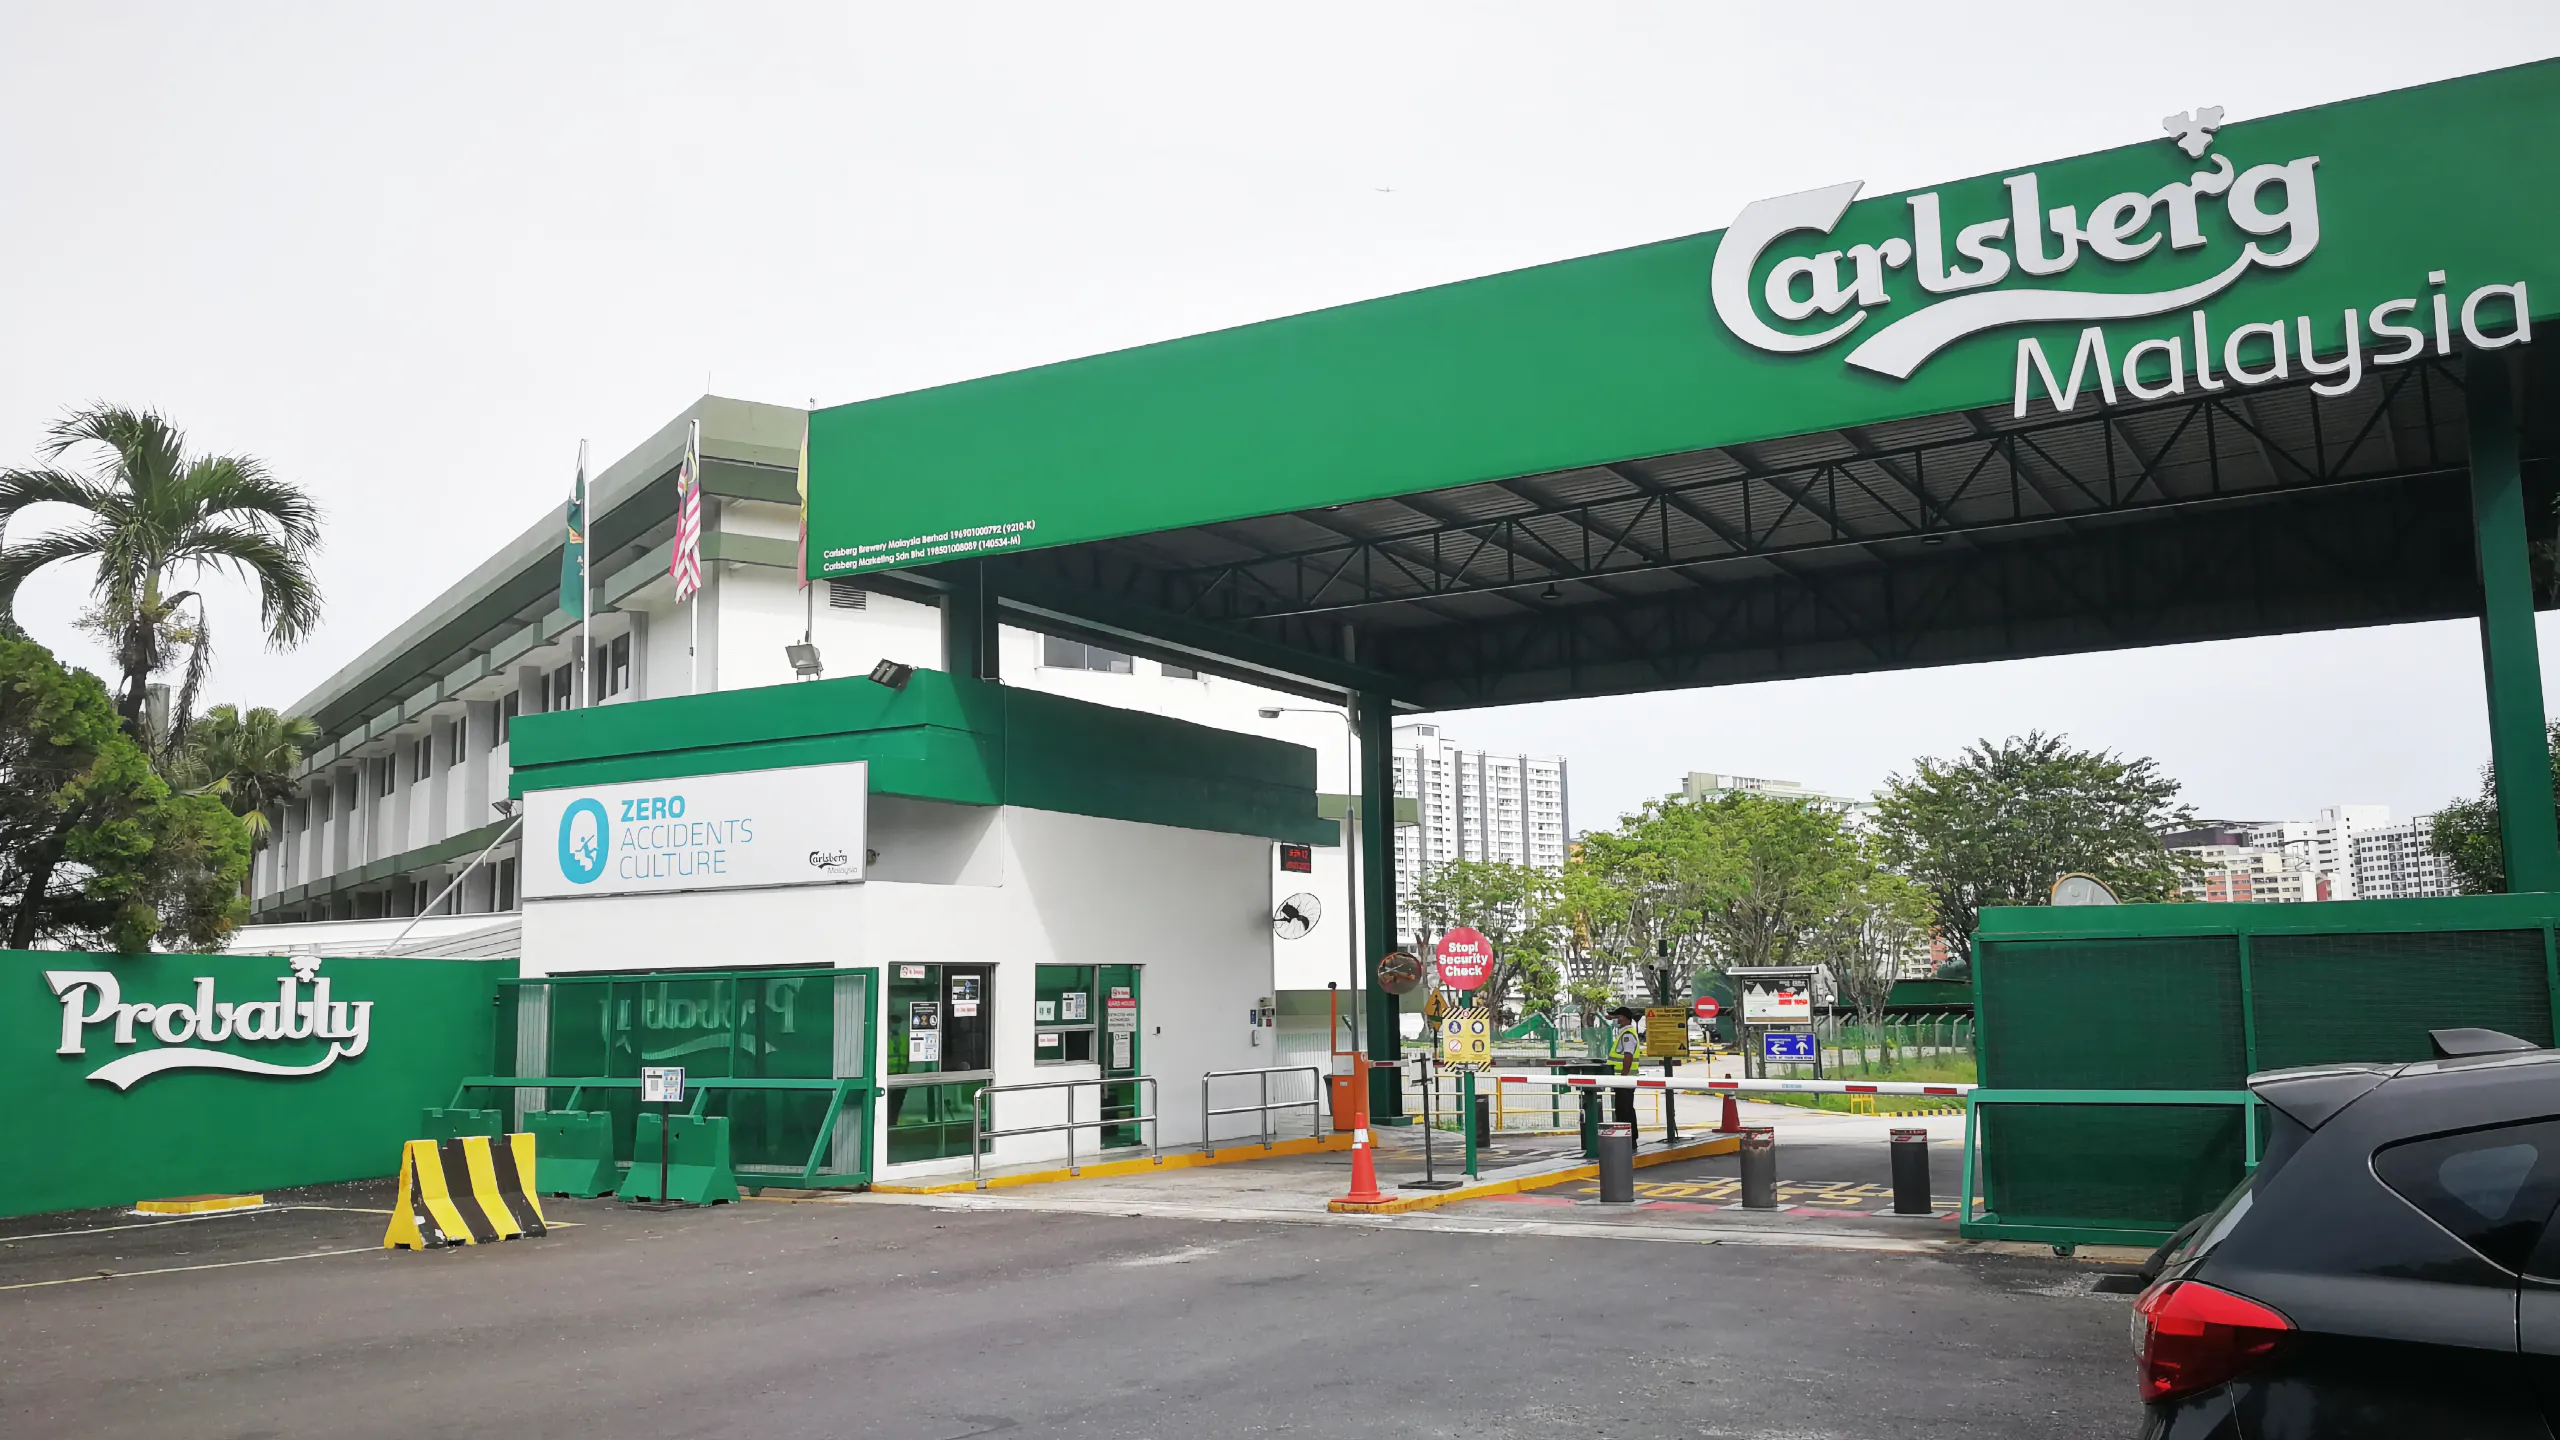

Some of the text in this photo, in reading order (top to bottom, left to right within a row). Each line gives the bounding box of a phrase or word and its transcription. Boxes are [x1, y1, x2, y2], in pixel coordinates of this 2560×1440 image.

[1711, 153, 2321, 355] Carlsberg
[2013, 269, 2532, 419] Malaysia
[823, 547, 858, 559] Carlsberg
[858, 543, 887, 555] Brewery
[888, 536, 921, 550] Malaysia
[922, 532, 949, 545] Berhad
[1003, 519, 1036, 535] (9210-K)
[823, 560, 858, 572] Carlsberg
[858, 553, 895, 567] Marketing
[895, 550, 910, 562] Sdn
[910, 548, 925, 559] Bhd
[620, 795, 686, 822] ZERO
[620, 818, 753, 851] ACCIDENTS
[619, 850, 727, 879] CULTURE
[809, 850, 848, 867] Carlsberg
[1439, 953, 1489, 966] Security
[1448, 941, 1479, 954] Stop!
[1445, 965, 1483, 977] Check
[43, 968, 375, 1059] Probably
